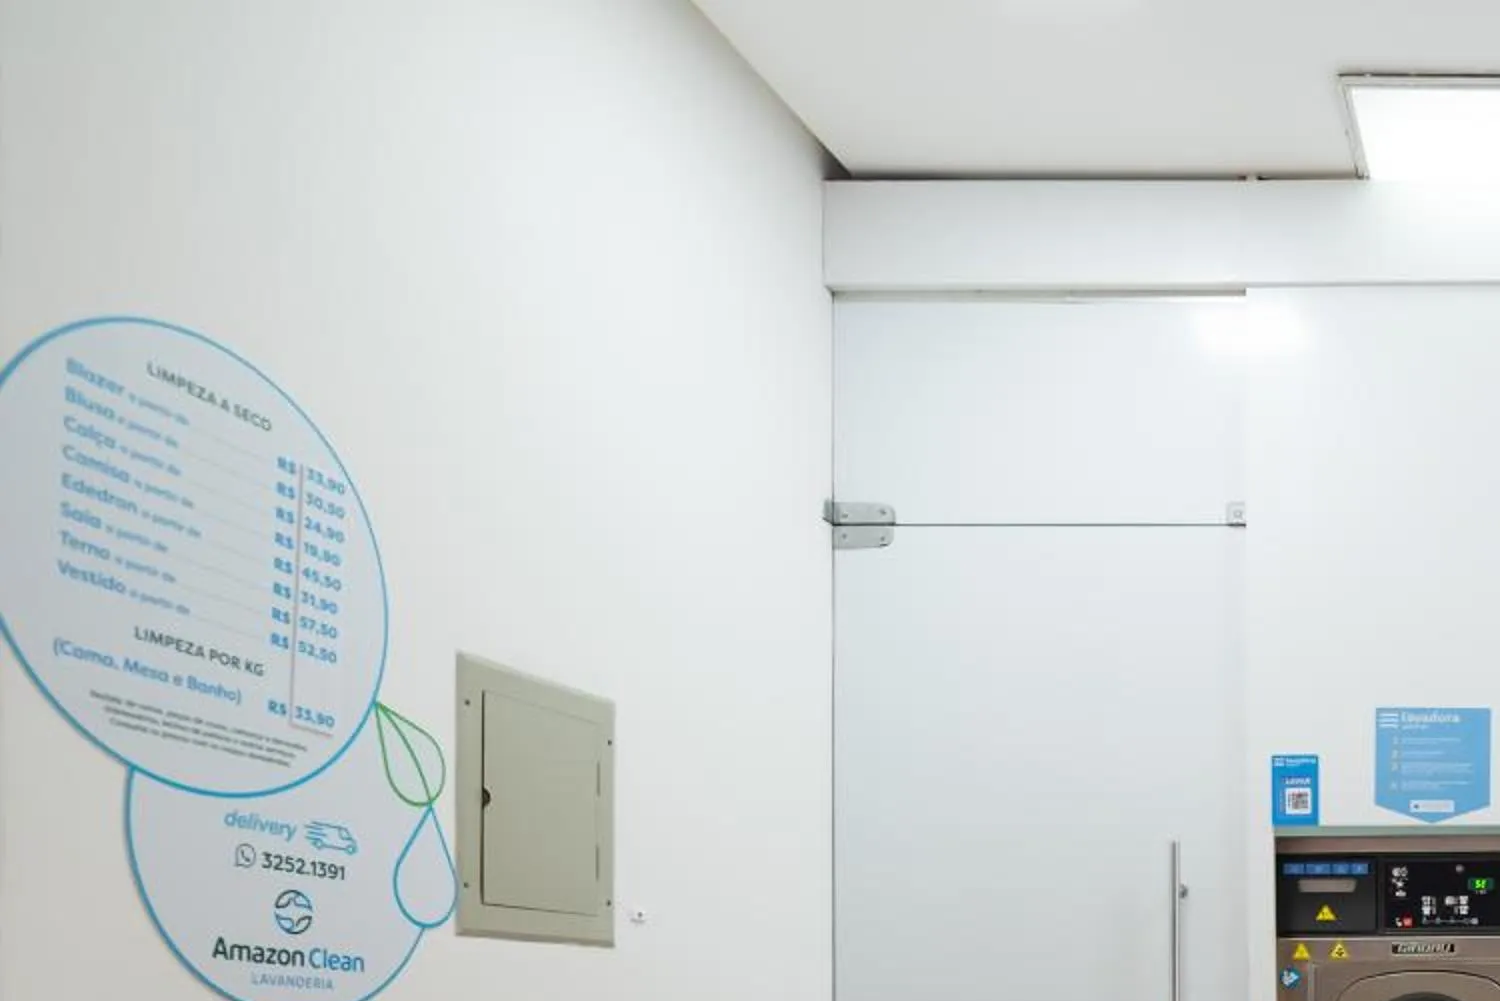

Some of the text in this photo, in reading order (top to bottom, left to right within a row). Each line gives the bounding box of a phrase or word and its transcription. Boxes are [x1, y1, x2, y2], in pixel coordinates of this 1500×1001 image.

[67, 357, 124, 396] Blazer
[65, 386, 115, 420] Blusa
[146, 360, 218, 406] LIMPEZA
[233, 404, 272, 432] SECO
[62, 445, 130, 483] Camisa
[60, 501, 101, 529] Saia
[60, 529, 110, 560] Terno
[58, 559, 126, 595] Vestido
[134, 626, 265, 677] LIMPEZA POR KG
[123, 657, 169, 683] Mesa
[173, 674, 183, 687] e
[187, 675, 242, 706] Banho)
[268, 699, 287, 716] R$
[224, 809, 297, 842] delivery
[261, 852, 346, 880] 3252.1391
[212, 937, 365, 973] Amazon Clean
[251, 973, 334, 990] LAVANDERIA
